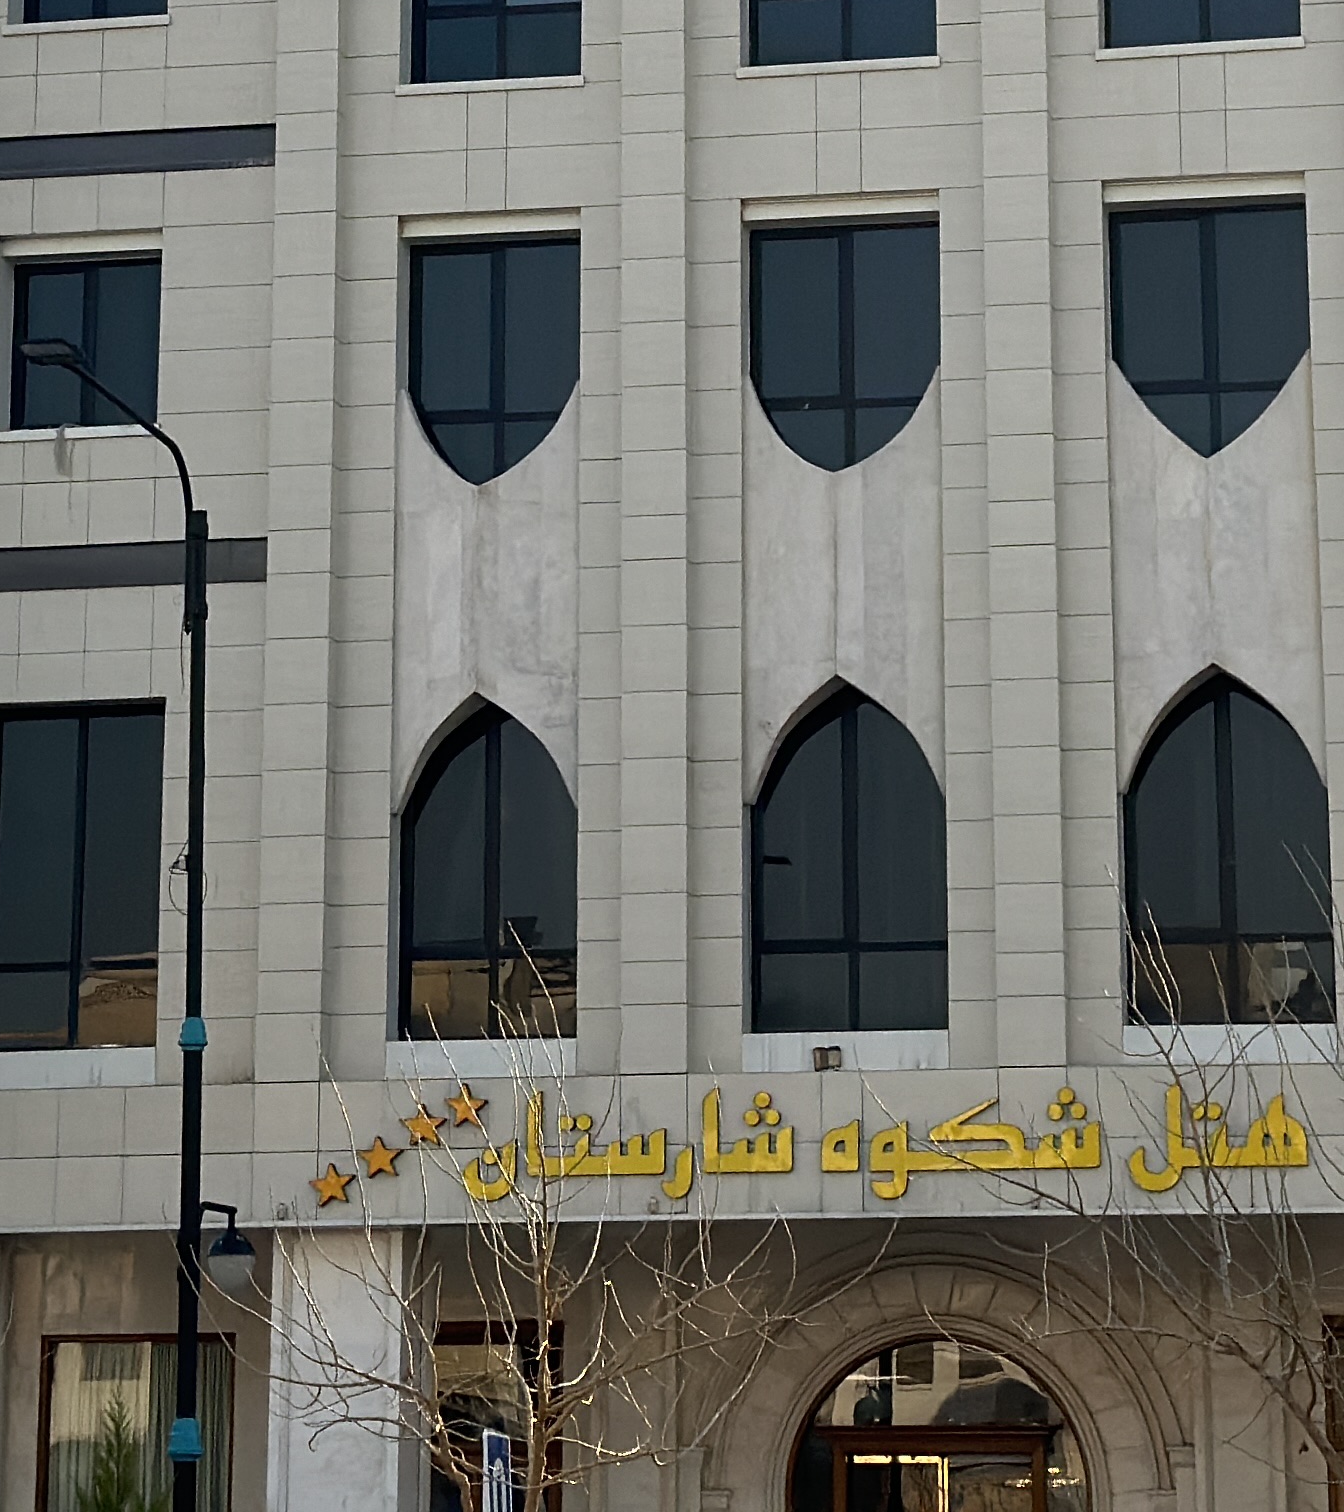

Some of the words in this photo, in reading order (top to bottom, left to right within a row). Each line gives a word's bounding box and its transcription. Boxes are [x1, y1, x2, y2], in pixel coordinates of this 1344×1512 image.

[462, 1088, 793, 1201] شارستان
[821, 1087, 1102, 1200] شکوه
[1128, 1084, 1309, 1193] هتل
